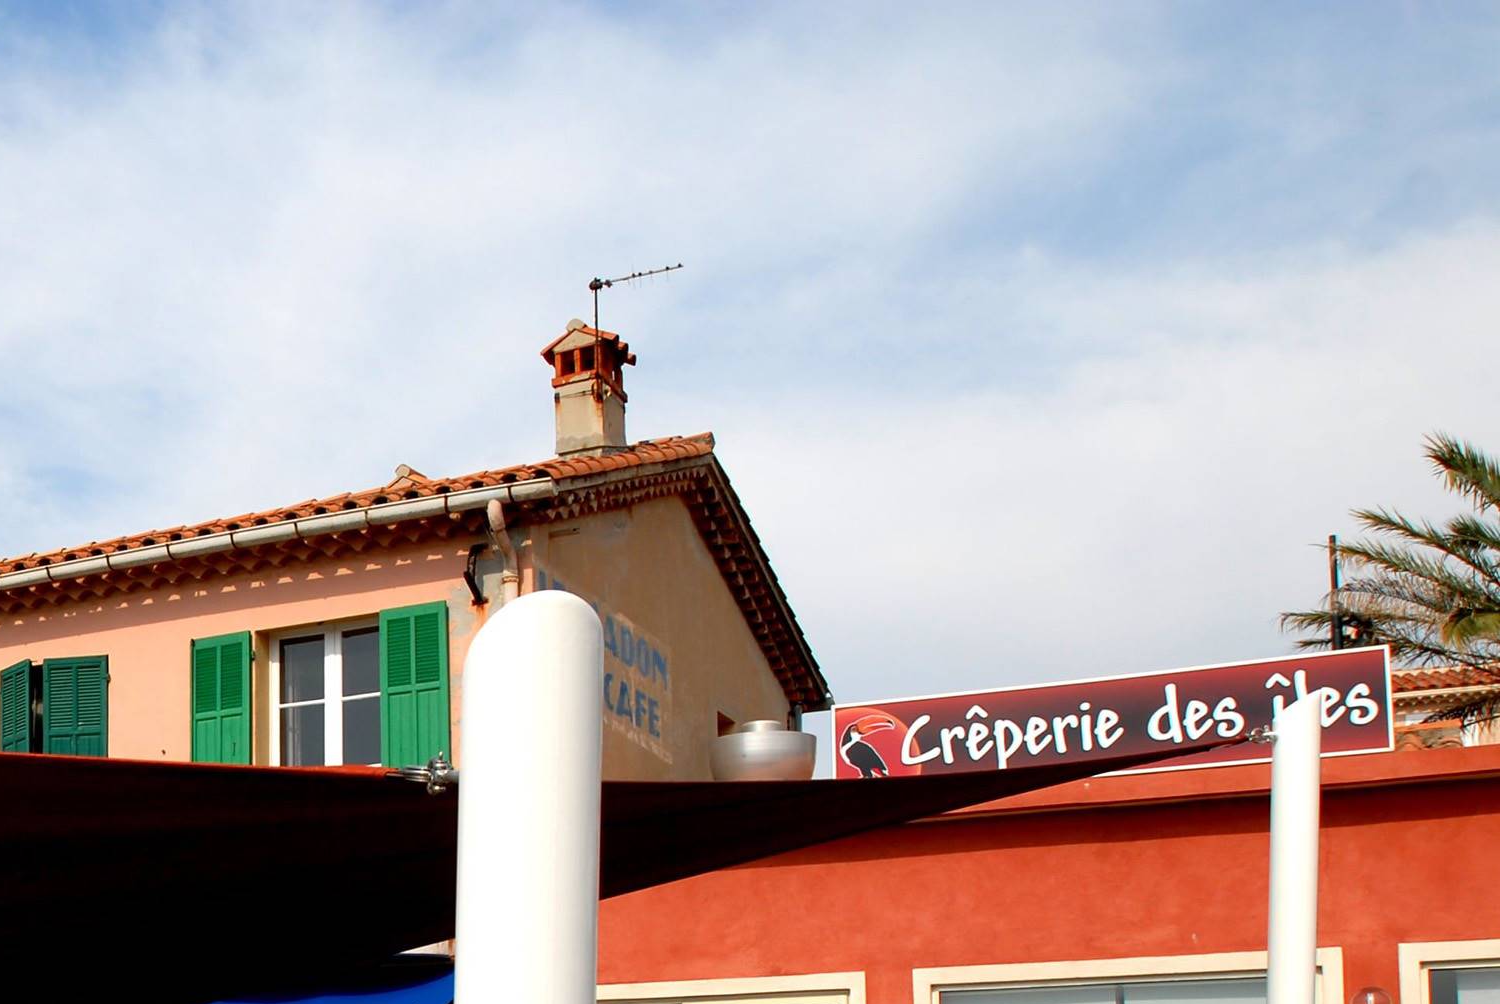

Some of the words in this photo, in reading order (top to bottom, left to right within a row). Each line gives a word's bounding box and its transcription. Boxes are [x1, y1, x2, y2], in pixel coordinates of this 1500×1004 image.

[603, 673, 660, 739] CAFE
[901, 702, 1124, 770] Crêperie
[1147, 683, 1245, 743] des
